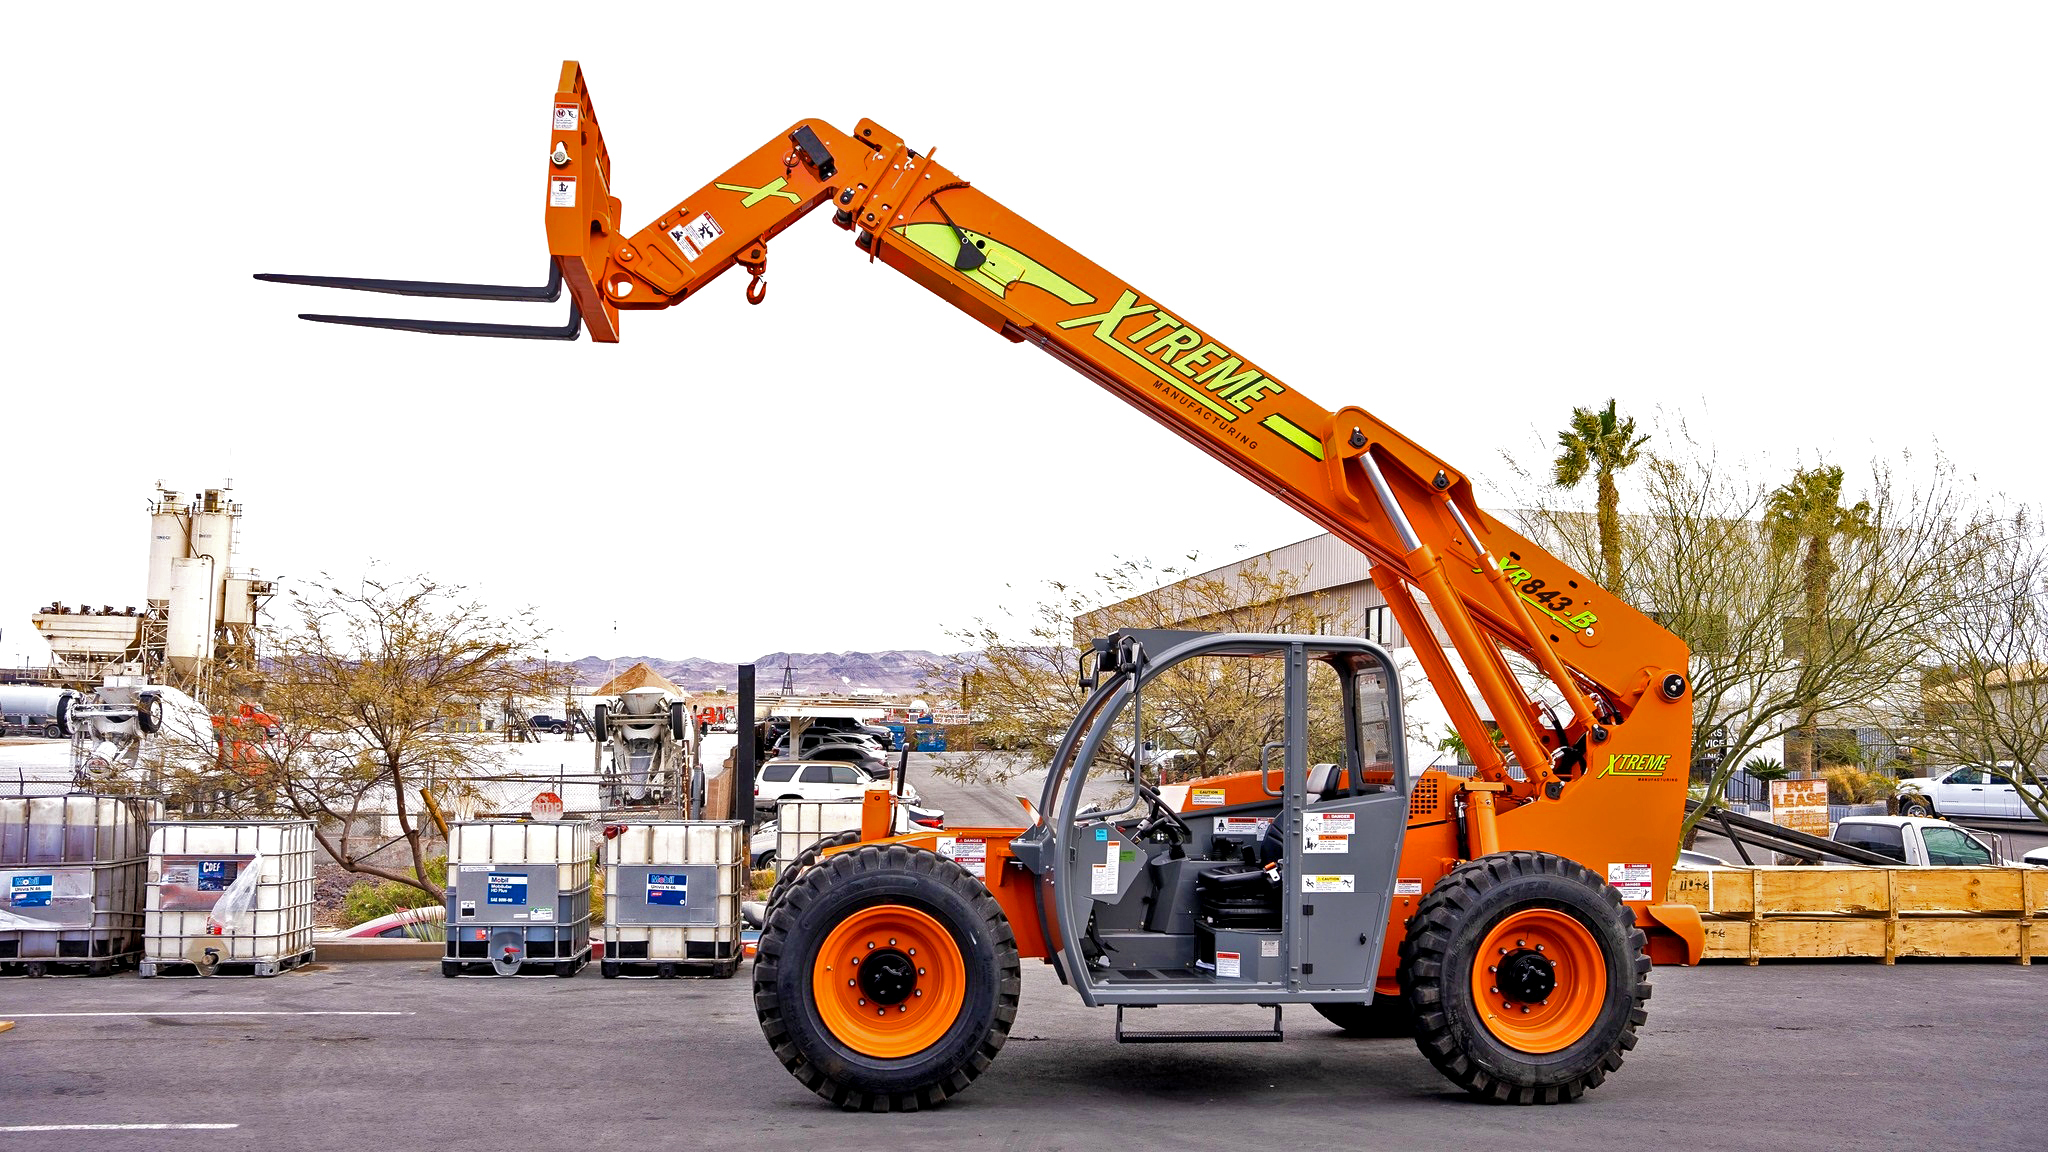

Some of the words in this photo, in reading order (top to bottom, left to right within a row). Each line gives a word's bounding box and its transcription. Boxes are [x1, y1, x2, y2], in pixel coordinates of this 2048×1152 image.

[1056, 289, 1287, 422] XTREME
[1152, 379, 1259, 451] MANUFACTURING
[1596, 753, 1672, 779] XTREME
[1786, 781, 1814, 793] FOR
[1773, 792, 1827, 808] LEASE
[533, 802, 562, 816] STOP
[15, 876, 40, 886] Mobil
[651, 875, 675, 884] Mobil
